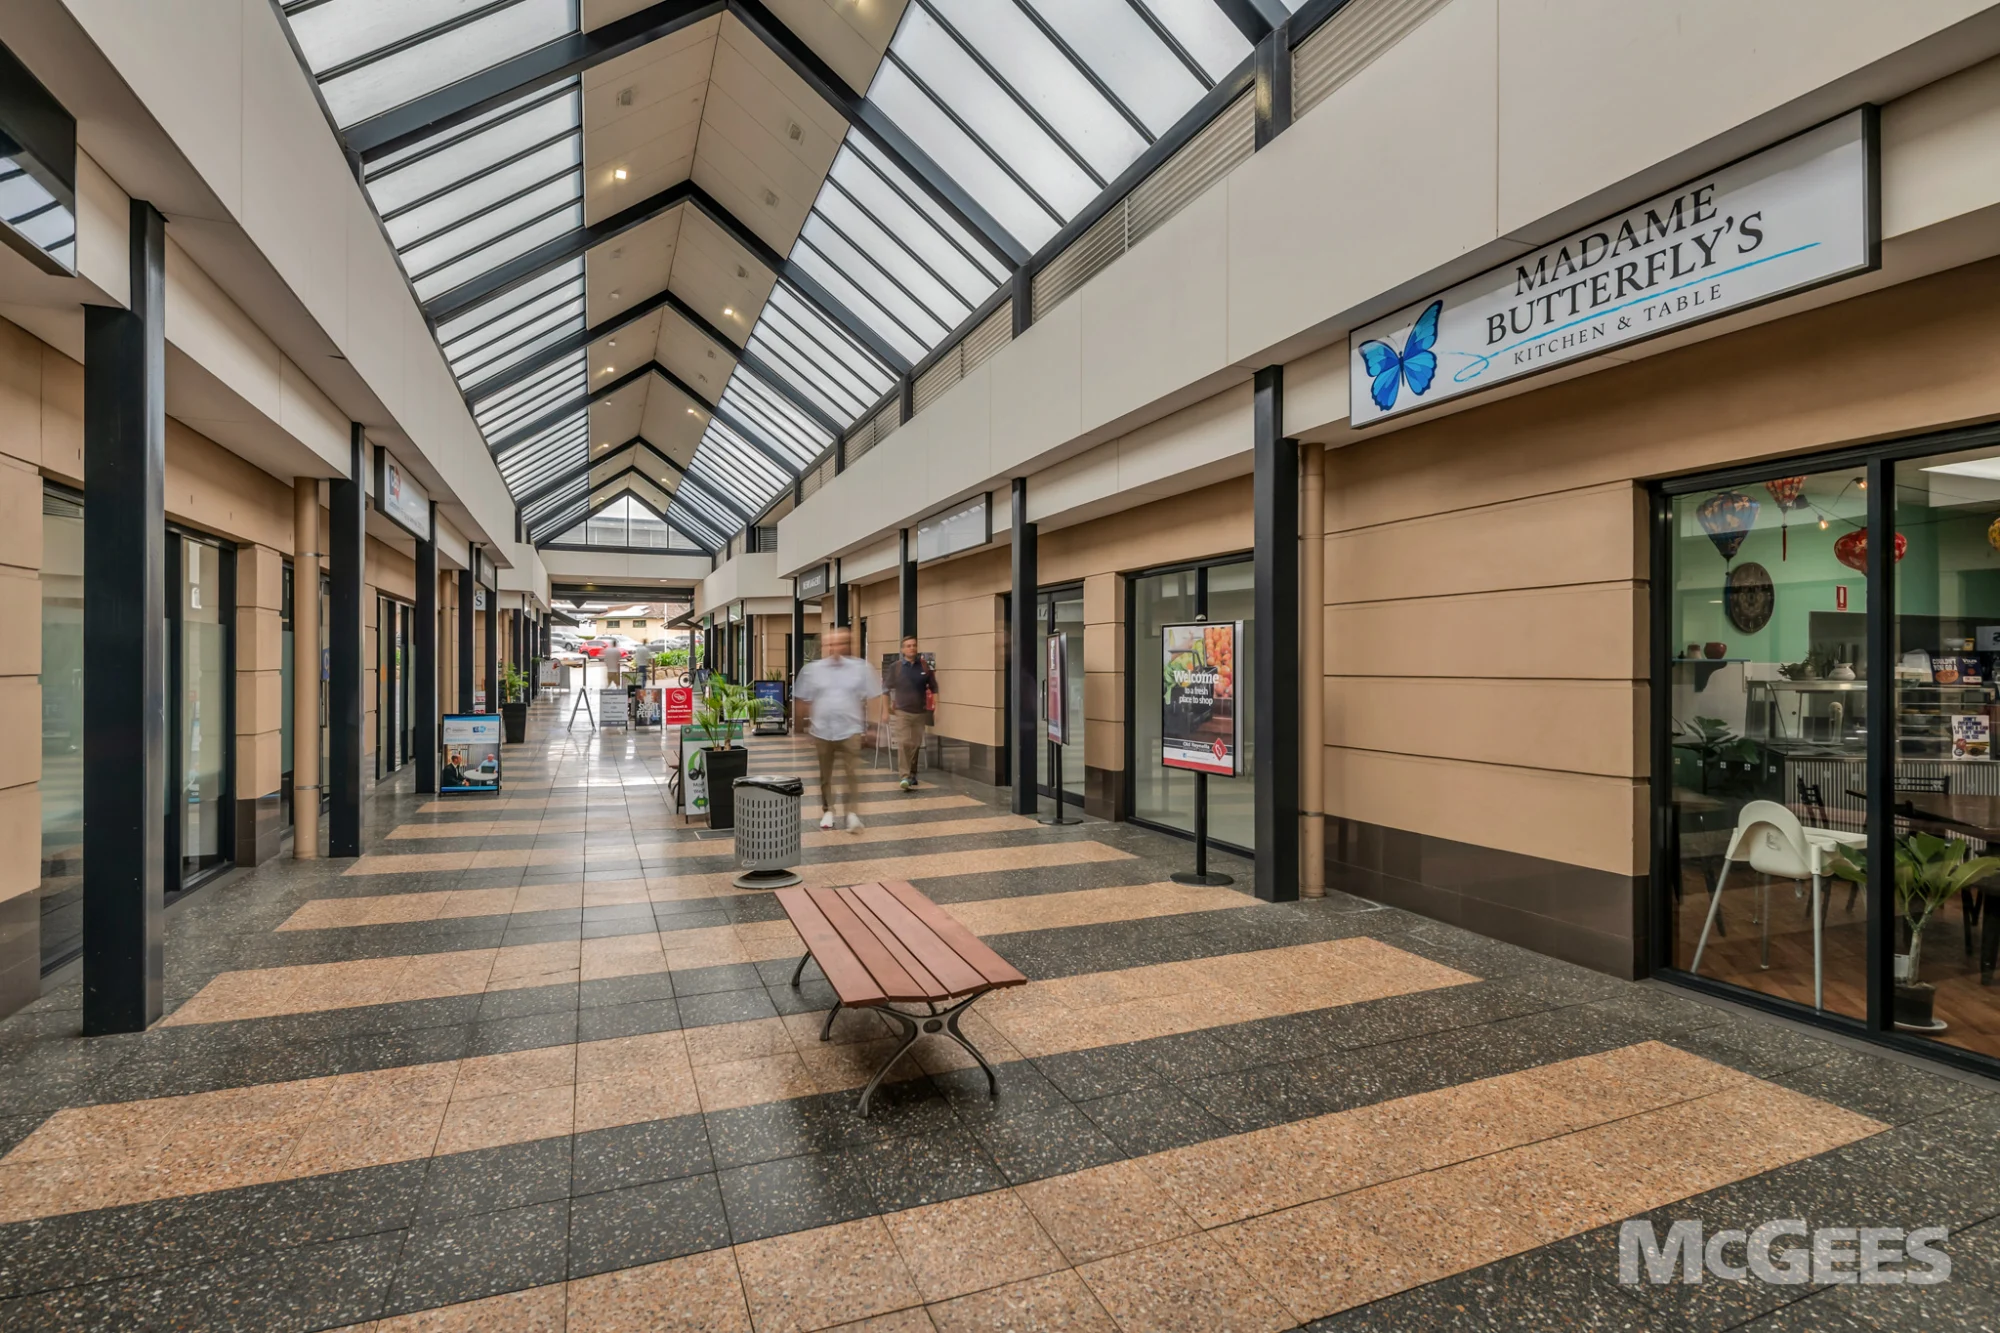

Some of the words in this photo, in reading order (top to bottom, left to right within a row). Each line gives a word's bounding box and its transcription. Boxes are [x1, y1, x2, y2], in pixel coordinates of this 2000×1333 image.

[1515, 183, 1718, 297] MADAME
[1486, 211, 1764, 345] BUTTERFLY'S
[1514, 323, 1606, 365] KITCHEN
[1617, 316, 1632, 331] &
[1643, 284, 1722, 321] TABLE
[1173, 670, 1219, 684] Welcome
[1194, 687, 1208, 695] fresh
[1179, 695, 1192, 704] place
[1192, 695, 1198, 704] to
[1199, 696, 1214, 707] shop
